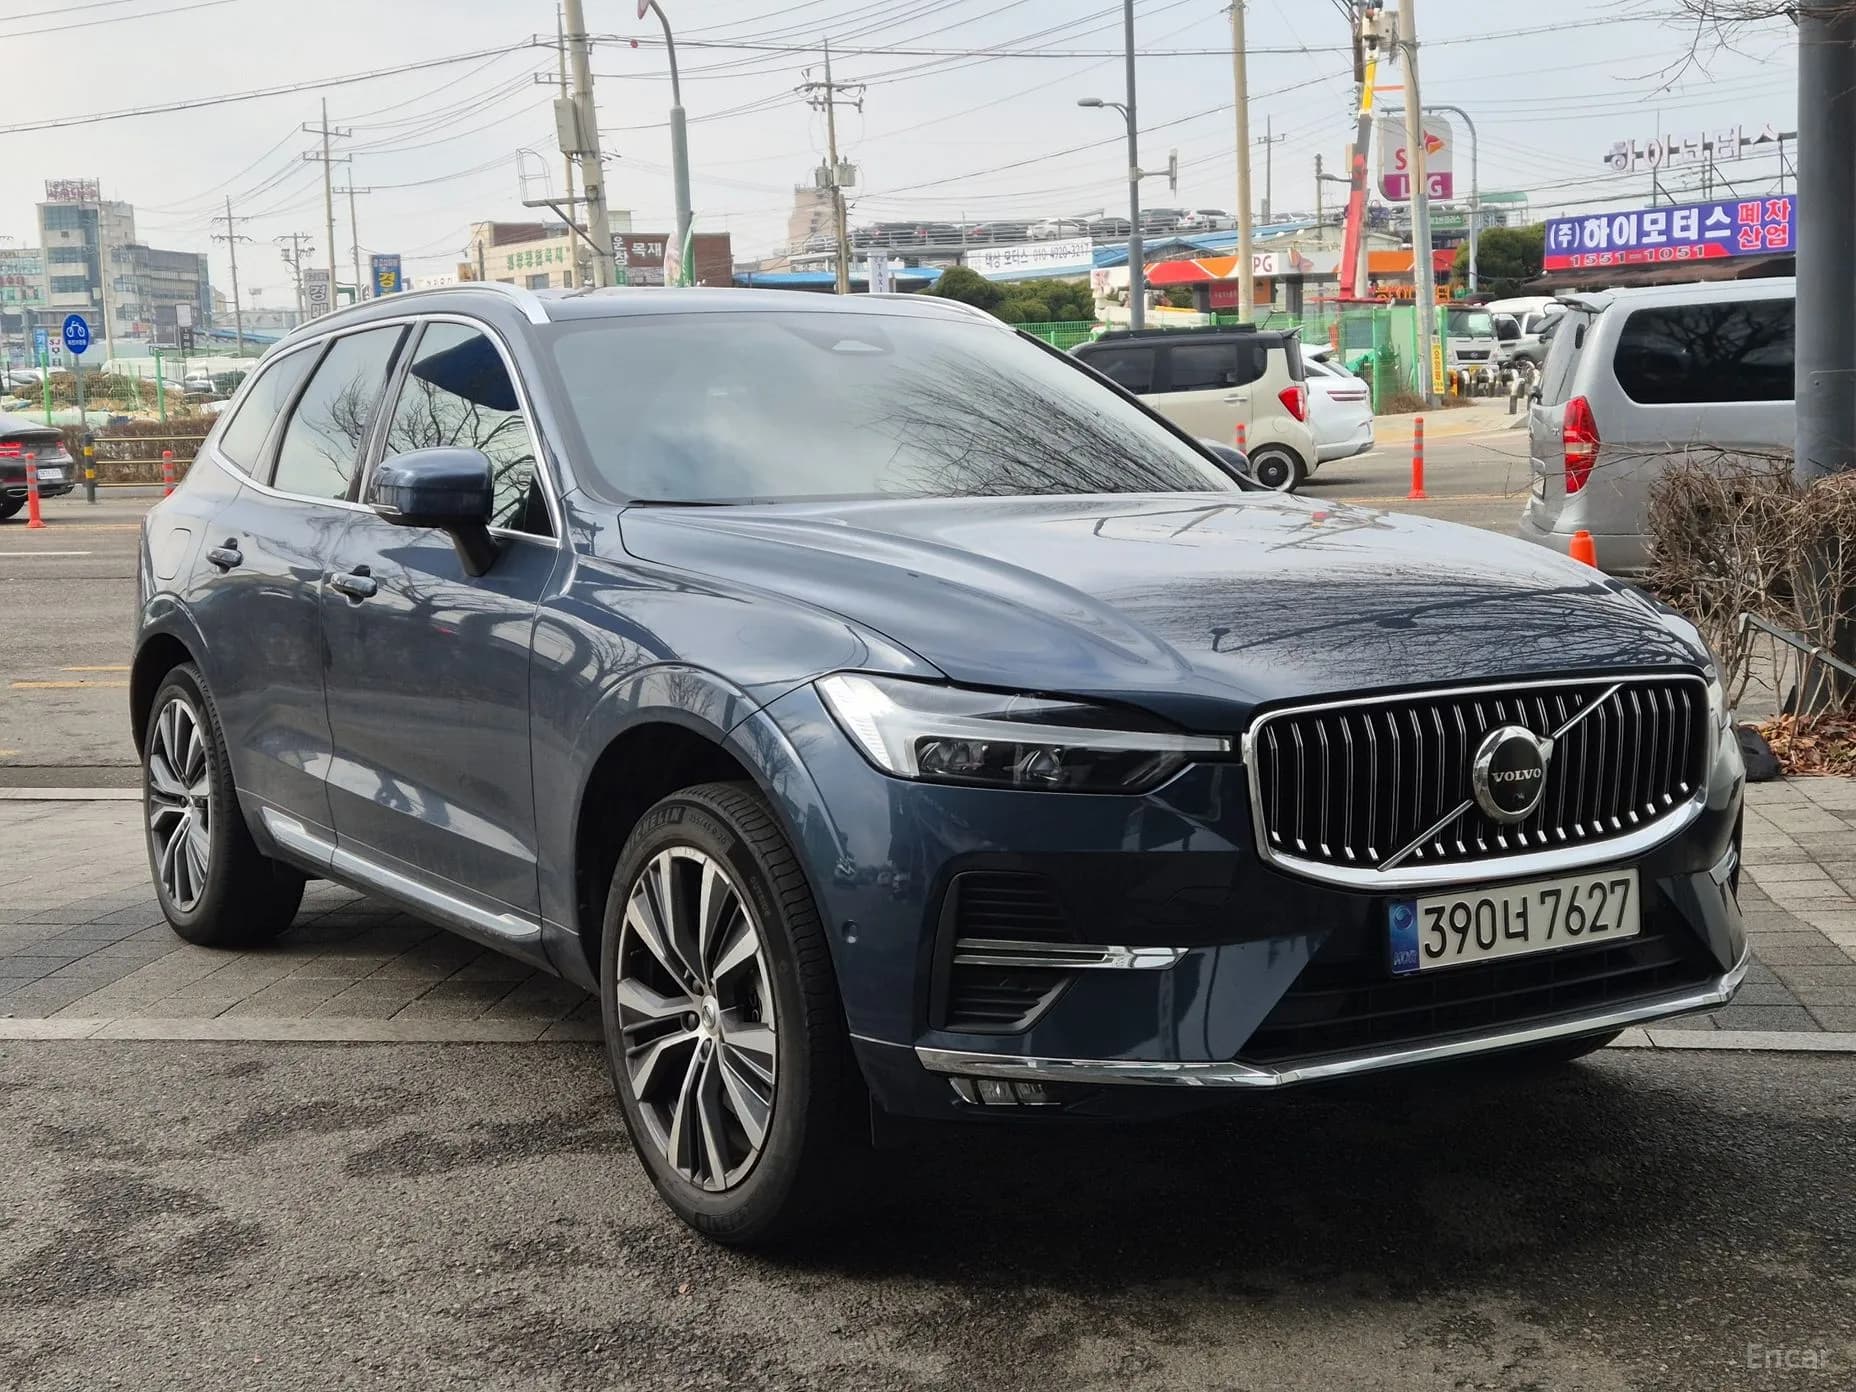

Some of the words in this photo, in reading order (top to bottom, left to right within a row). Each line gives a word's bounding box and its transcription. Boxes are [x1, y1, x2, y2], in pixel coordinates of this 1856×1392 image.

[1400, 175, 1442, 198] LG
[1550, 206, 1731, 250] (주)하이모터스
[1738, 222, 1789, 251] 산업
[631, 241, 663, 258] 목재
[1570, 244, 1705, 269] 1551-1051
[1253, 255, 1273, 273] PG
[1491, 768, 1542, 783] VOLVO
[1424, 897, 1529, 959] 390너
[1540, 878, 1631, 940] 7627
